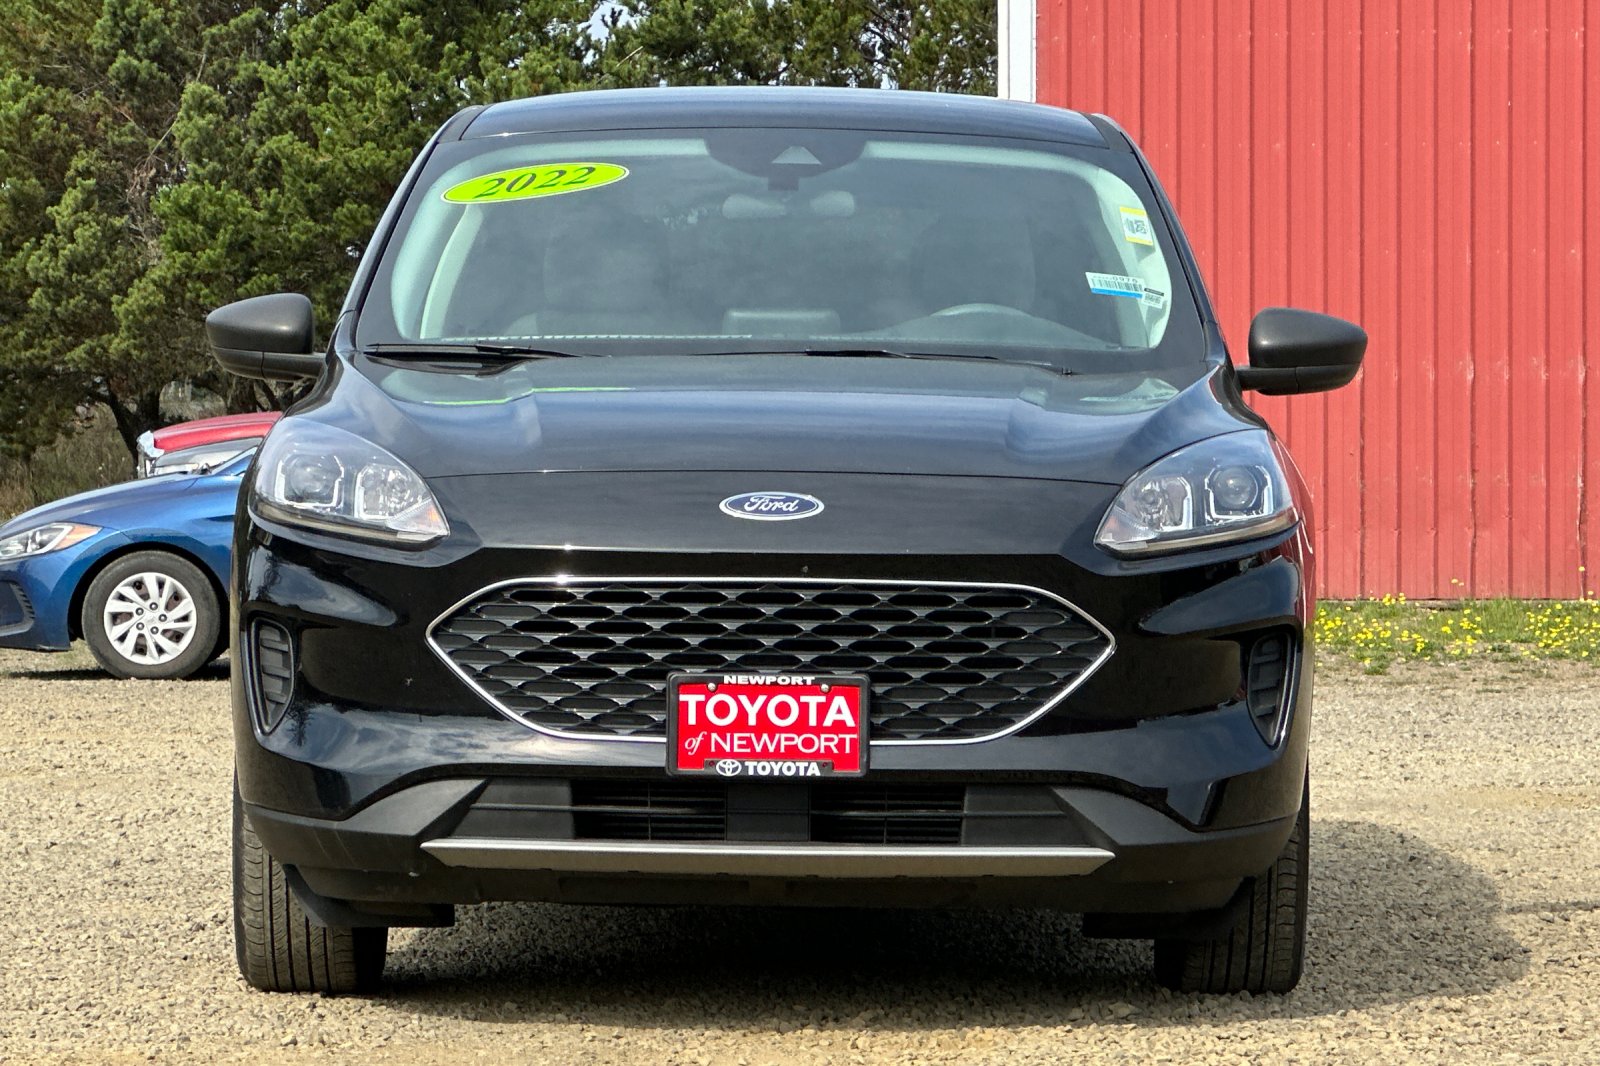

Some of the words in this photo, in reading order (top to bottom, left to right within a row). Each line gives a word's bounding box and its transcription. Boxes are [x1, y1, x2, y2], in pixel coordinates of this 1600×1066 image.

[472, 166, 596, 199] 2022
[743, 495, 800, 512] Ford
[723, 675, 815, 685] NEWPORT
[679, 693, 856, 727] TOYOTA
[684, 731, 707, 755] of
[710, 732, 857, 754] NEWPORT
[745, 761, 821, 776] TOYOTA
